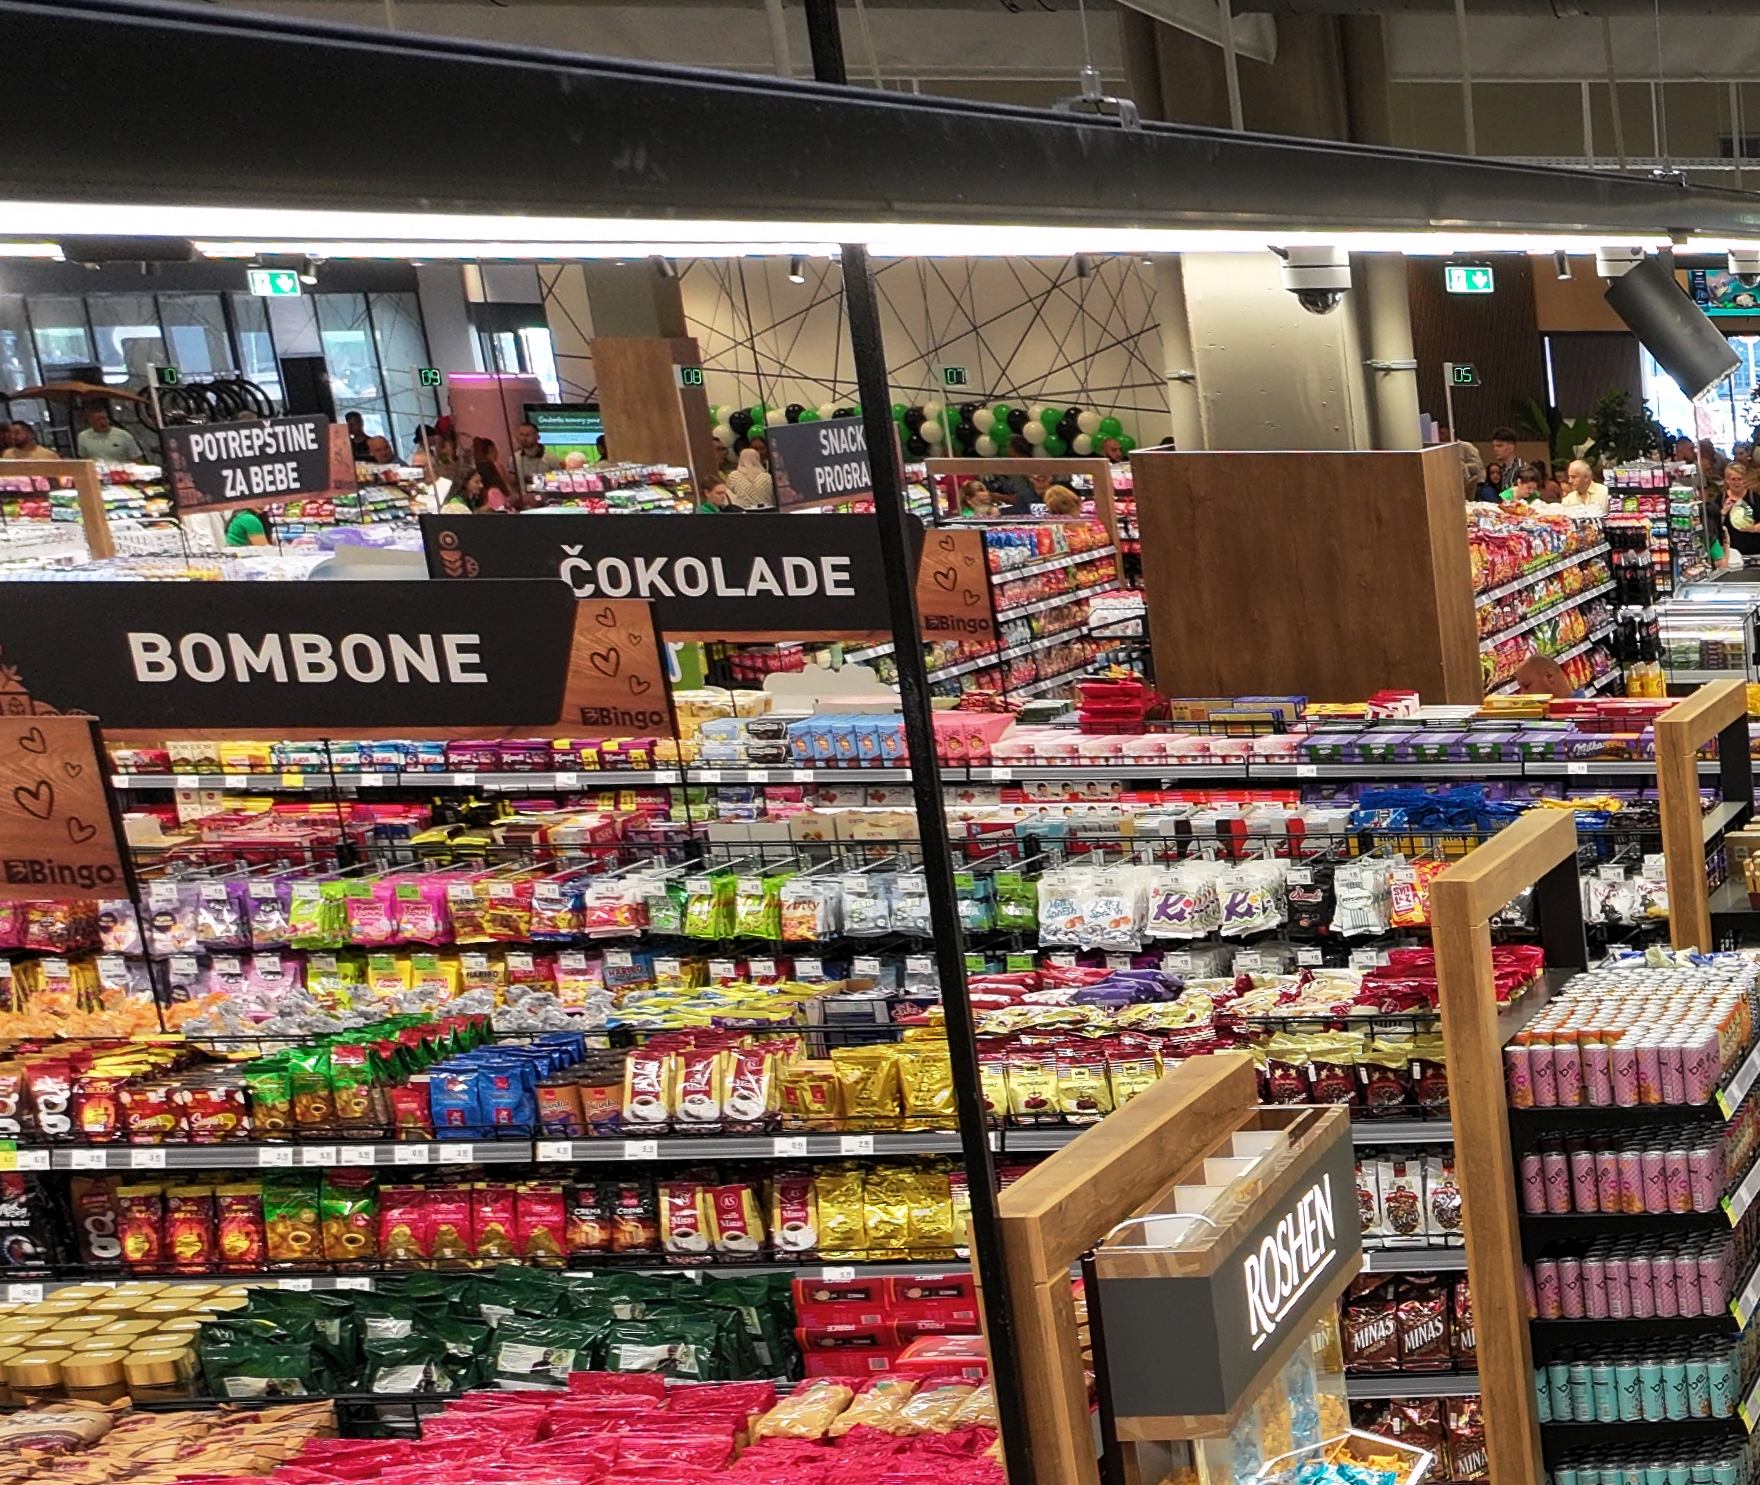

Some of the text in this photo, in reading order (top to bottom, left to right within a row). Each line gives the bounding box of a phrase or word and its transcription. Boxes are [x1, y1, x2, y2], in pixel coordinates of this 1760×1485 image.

[190, 420, 318, 463] POTREPŠTINE
[820, 424, 866, 456] SNACK
[222, 461, 301, 498] ZA BEBE
[815, 461, 873, 494] PROGRA
[559, 545, 855, 598] ČOKOLADE
[127, 632, 488, 684] BOMBONE
[599, 707, 664, 729] Bingo
[30, 861, 117, 889] Bingo
[1244, 1173, 1336, 1336] ROSHEN
[1405, 1316, 1444, 1352] MINAS
